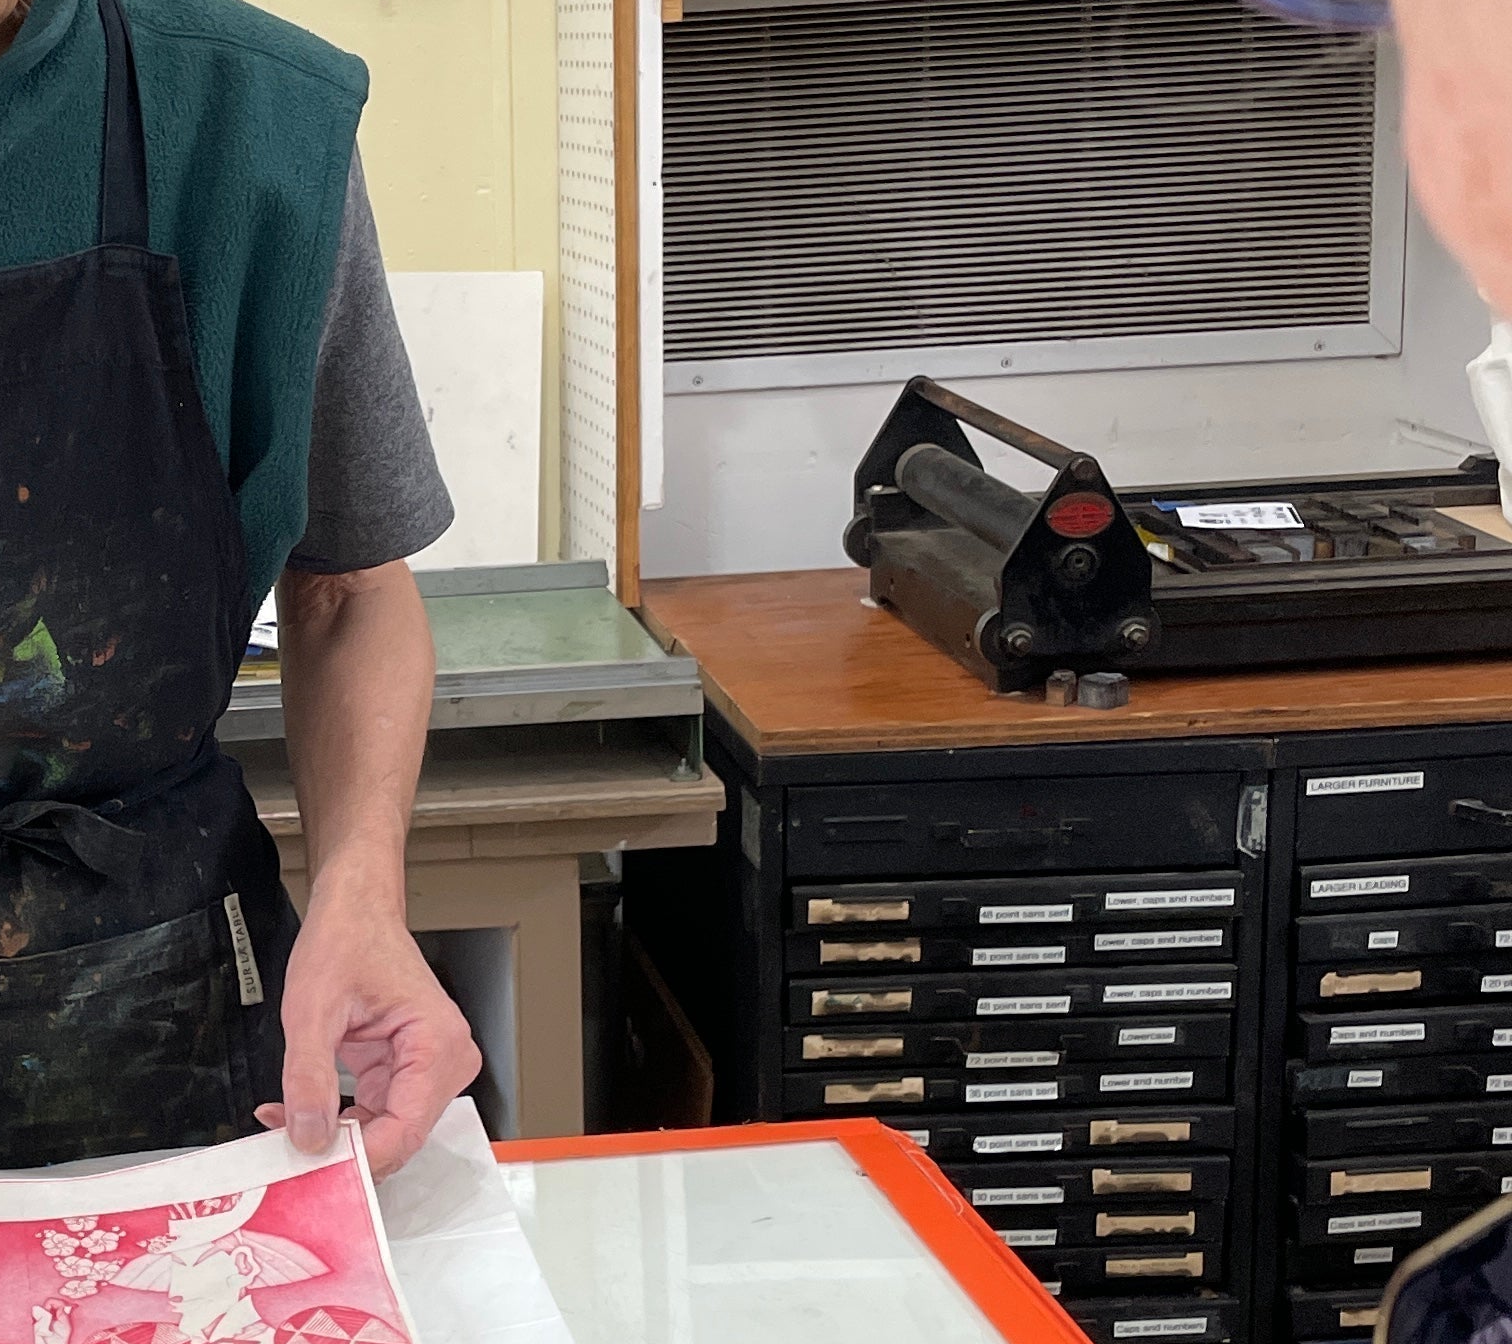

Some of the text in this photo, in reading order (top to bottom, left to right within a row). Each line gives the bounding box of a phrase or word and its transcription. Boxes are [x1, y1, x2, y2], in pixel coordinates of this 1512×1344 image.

[1311, 774, 1421, 790] LARGER FURNITURE
[1312, 879, 1407, 894] LARGER LEADING
[1142, 895, 1166, 906] caps
[1169, 894, 1187, 903] and
[1190, 892, 1232, 903] numbers
[996, 909, 1019, 920] point
[1022, 909, 1046, 918] sans
[1048, 908, 1069, 918] serif
[1131, 936, 1154, 946] caps
[1157, 935, 1175, 944] and
[1178, 933, 1221, 944] numbers
[989, 950, 1063, 962] point sans serif
[242, 967, 256, 994] SUR
[1139, 988, 1163, 998] caps
[1166, 986, 1184, 995] and
[1187, 985, 1228, 996] numbers
[993, 1001, 1017, 1012] point
[1020, 1001, 1043, 1009] sans
[1121, 1030, 1173, 1041] Lowercase
[1332, 1028, 1422, 1040] Caps and numbers
[984, 1055, 1007, 1065] point
[1010, 1054, 1033, 1063] sans
[1102, 1077, 1130, 1087] Lower
[1134, 1076, 1152, 1085] and
[1351, 1075, 1380, 1084] Lower
[984, 1088, 1007, 1099] point
[1010, 1088, 1033, 1097] sans
[989, 1138, 1012, 1149] point
[1015, 1137, 1037, 1147] sans
[989, 1192, 1012, 1203] point
[1015, 1191, 1038, 1201] sans
[1041, 1189, 1062, 1200] serif
[1357, 1219, 1375, 1228] and
[1009, 1233, 1032, 1243] sans
[1116, 1322, 1204, 1334] Caps and numbers
